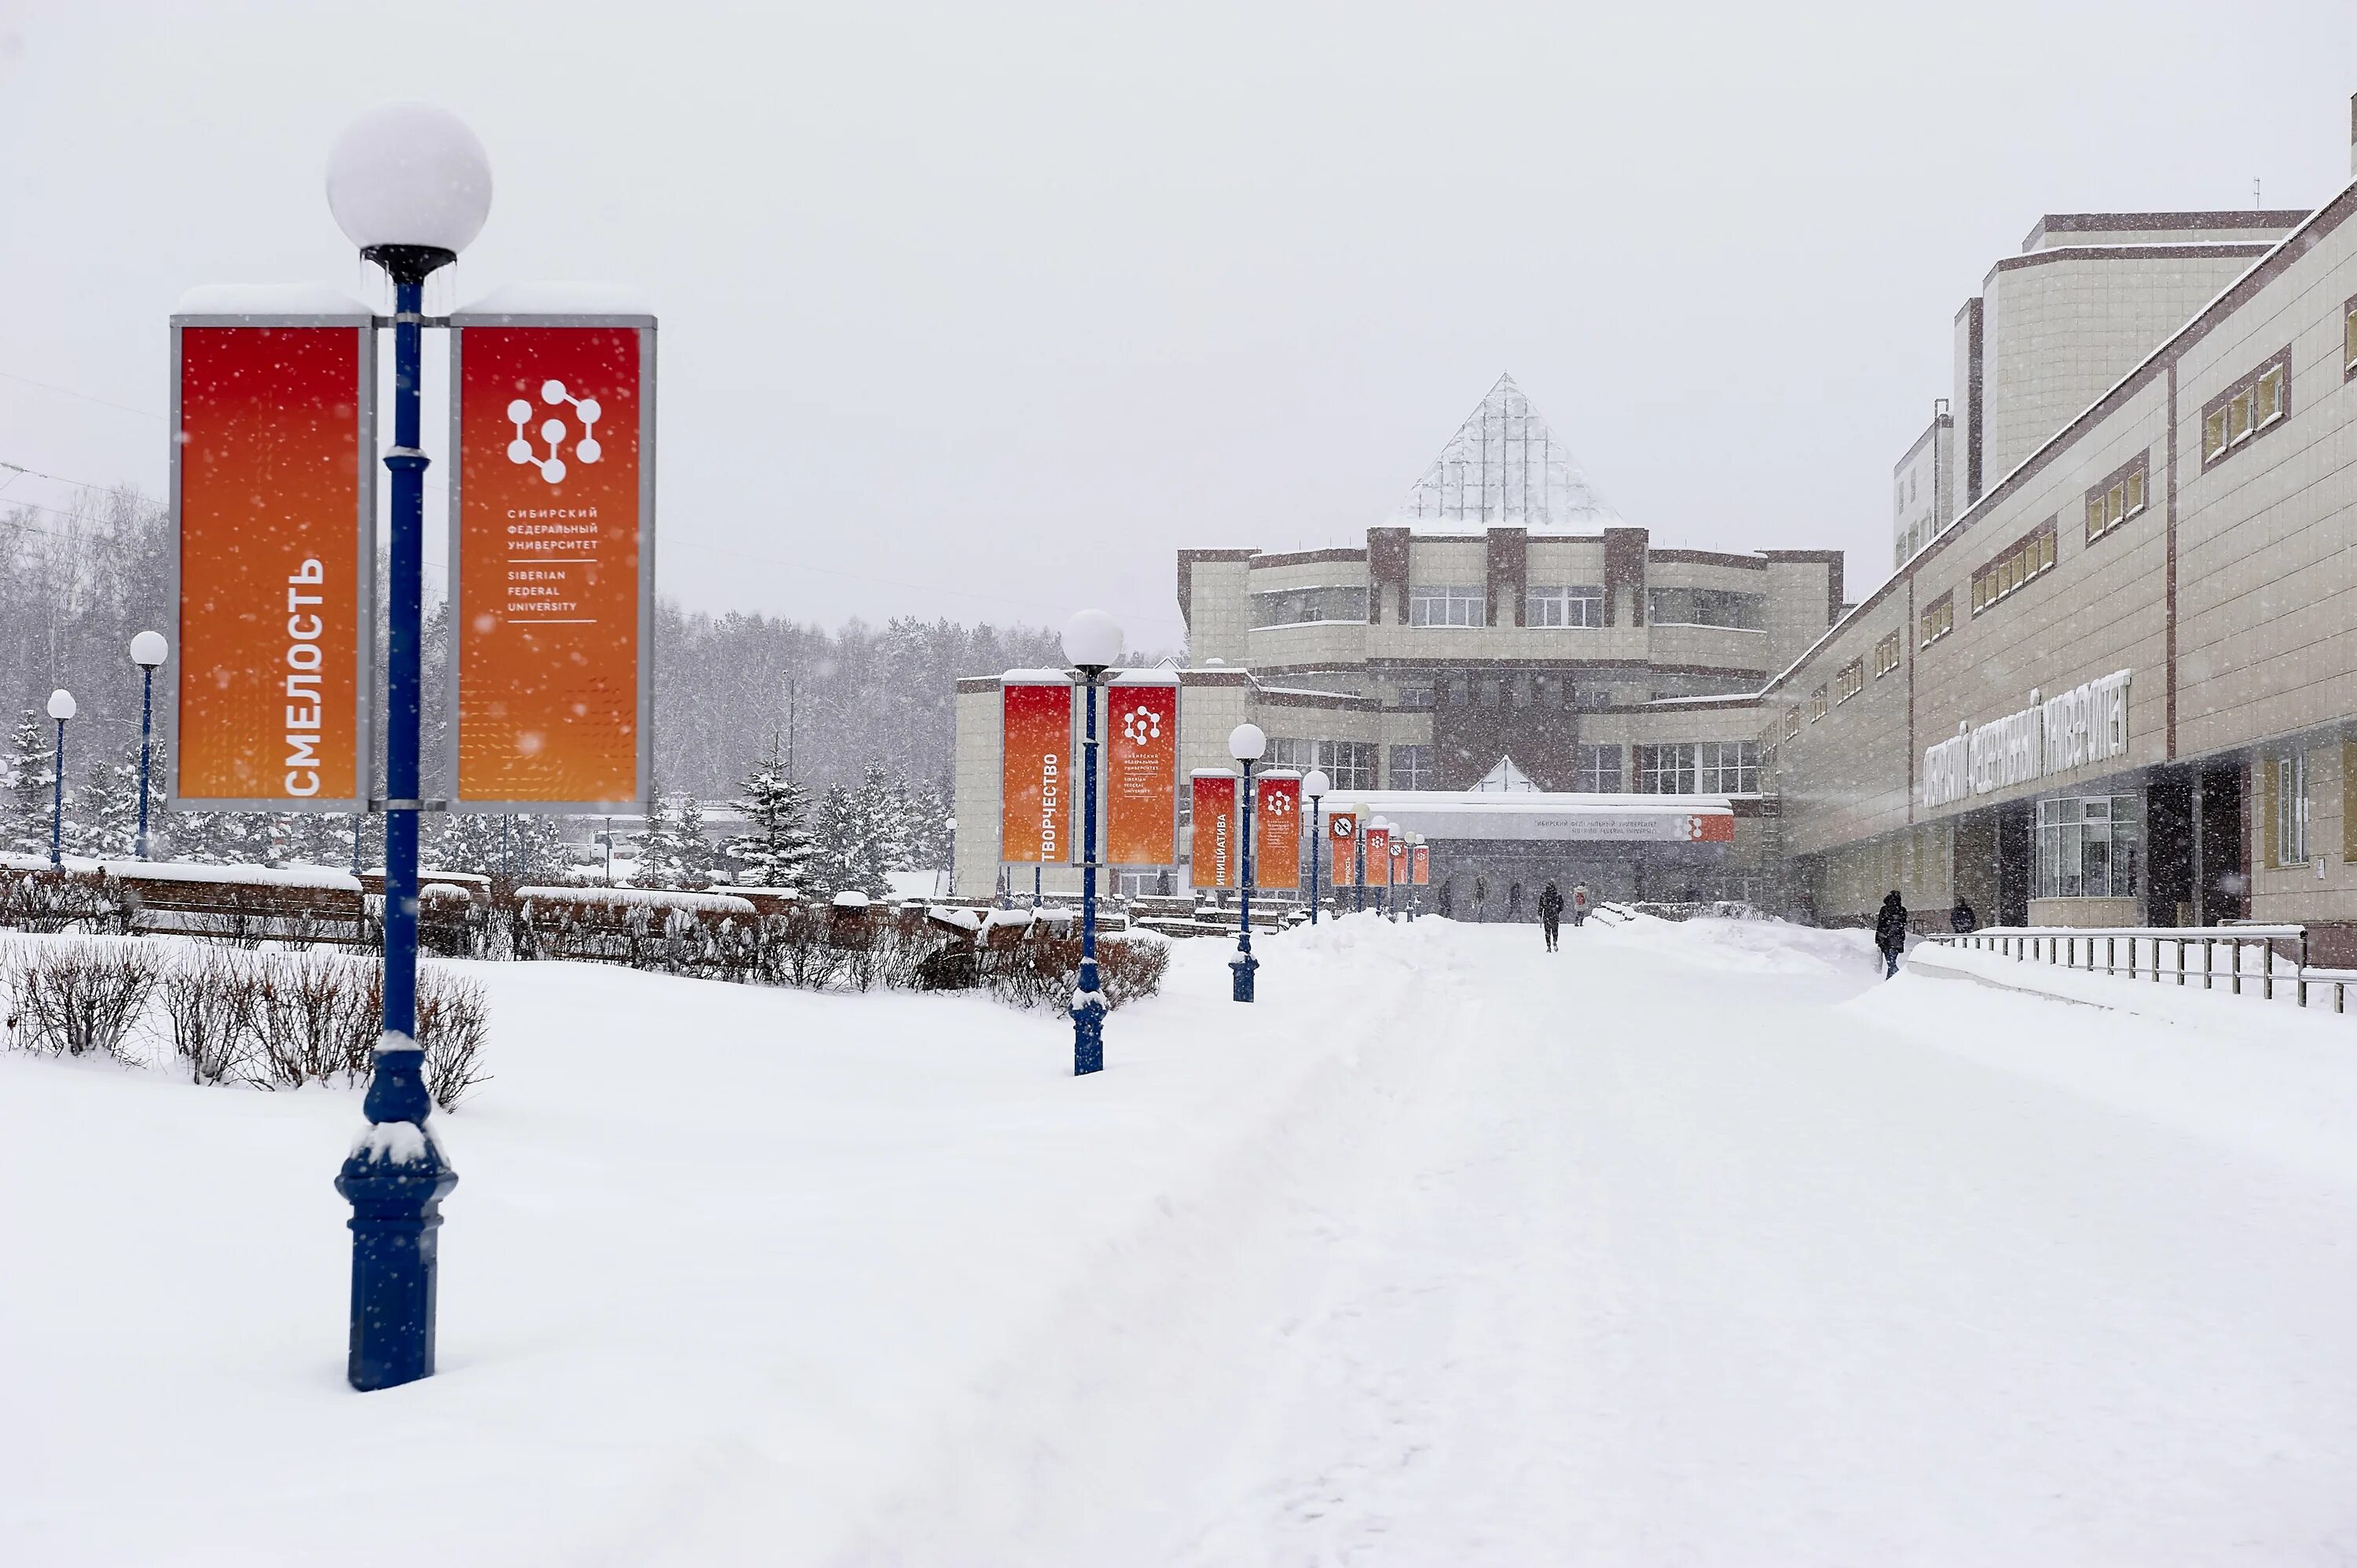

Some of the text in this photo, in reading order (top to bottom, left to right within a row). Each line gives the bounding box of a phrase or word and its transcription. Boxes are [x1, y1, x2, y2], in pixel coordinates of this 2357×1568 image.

[508, 507, 597, 518] СИБИРСКИЙ
[508, 523, 598, 535] ФЕДЕРАЛЬНЫЙ
[508, 540, 598, 550] УНИВЕРСИТЕТ
[508, 571, 566, 581] SIBERIAN
[508, 587, 560, 595] FEDERAL
[508, 603, 577, 612] UNIVERSITY
[284, 559, 324, 797] СМЕЛОСТЬ
[1041, 754, 1058, 863] ТВОРЧЕСТВО
[1216, 814, 1226, 885] ИНИЦИАТИВА
